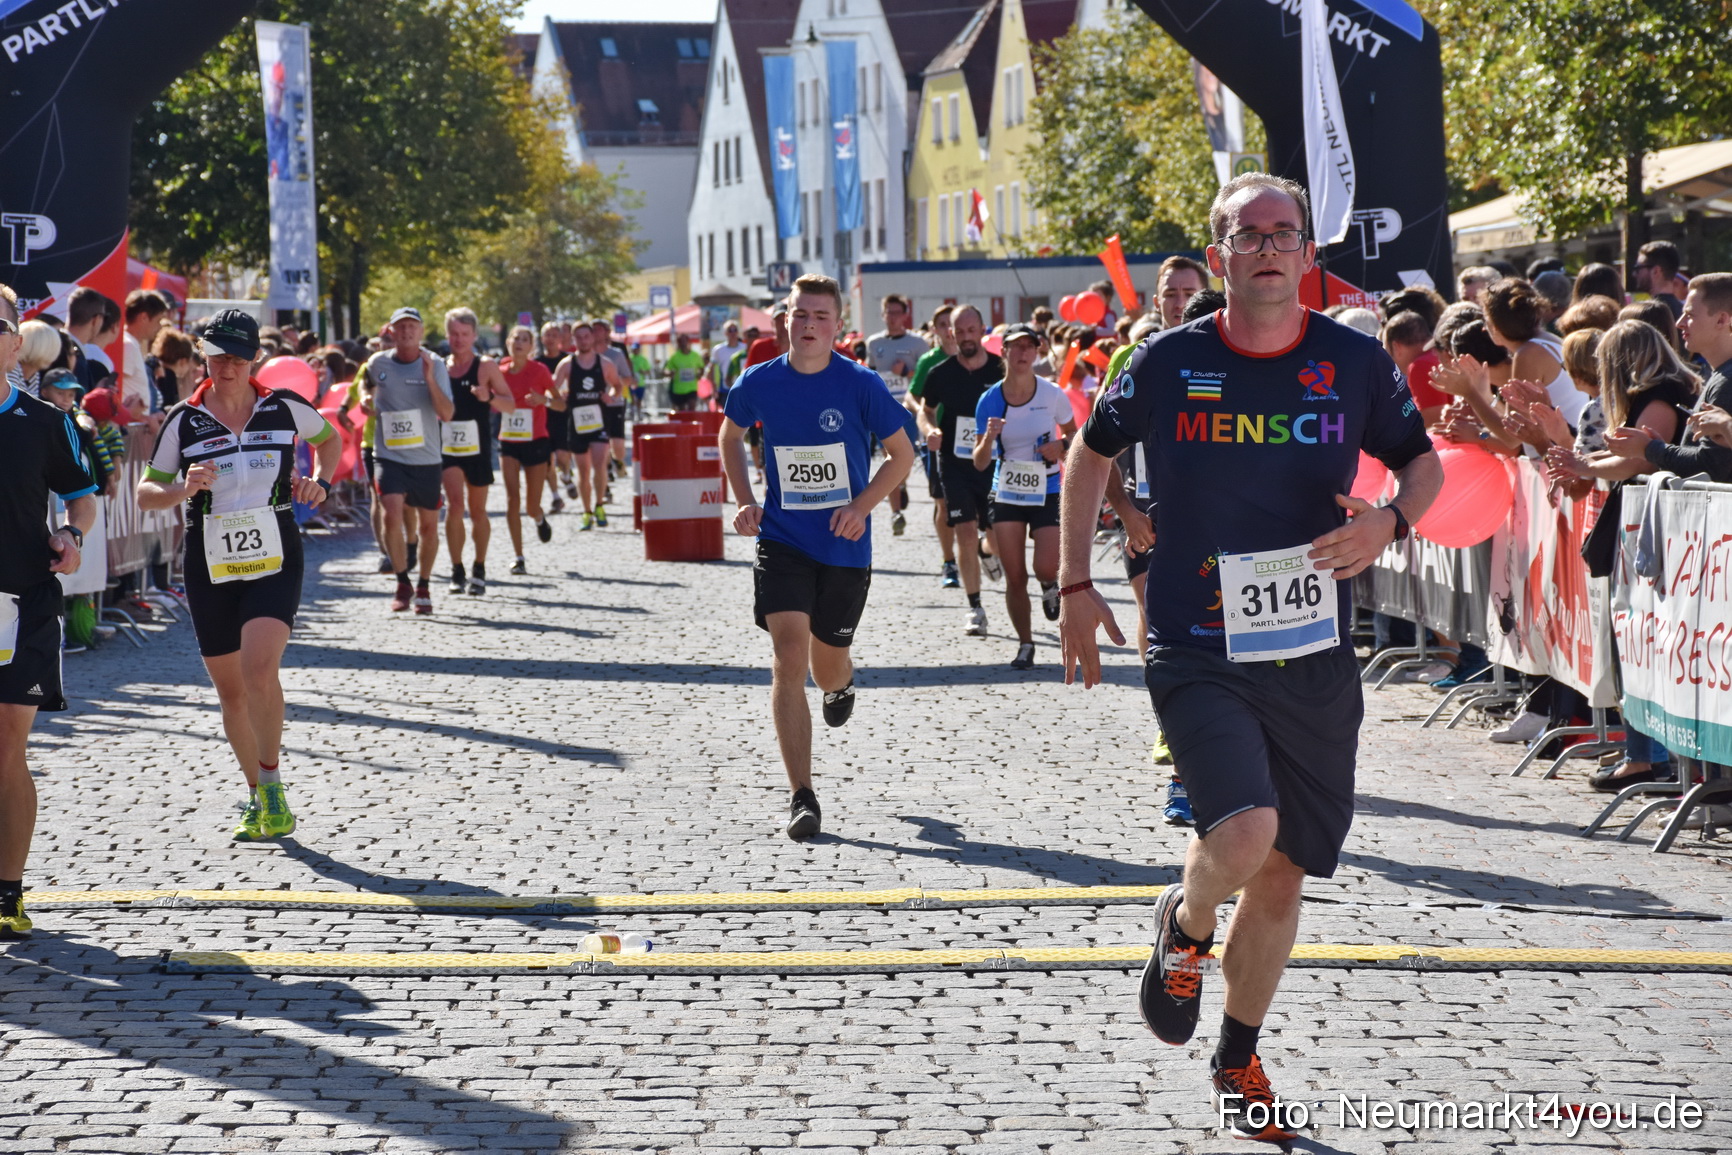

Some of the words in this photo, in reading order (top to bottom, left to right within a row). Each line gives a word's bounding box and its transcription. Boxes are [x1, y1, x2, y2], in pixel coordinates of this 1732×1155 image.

[1, 0, 107, 63] PARTL
[1339, 293, 1363, 305] THE
[391, 421, 413, 434] 352
[508, 417, 525, 428] 147
[1175, 412, 1345, 445] MENSCH
[452, 431, 466, 442] 72
[787, 462, 837, 483] 2590
[1005, 471, 1040, 488] 2498
[221, 528, 263, 553] 123
[226, 562, 266, 574] Christina
[1255, 555, 1304, 574] BOCK
[1241, 573, 1322, 618] 3146
[1250, 620, 1276, 628] PARTL
[1277, 614, 1310, 625] Neumarkt
